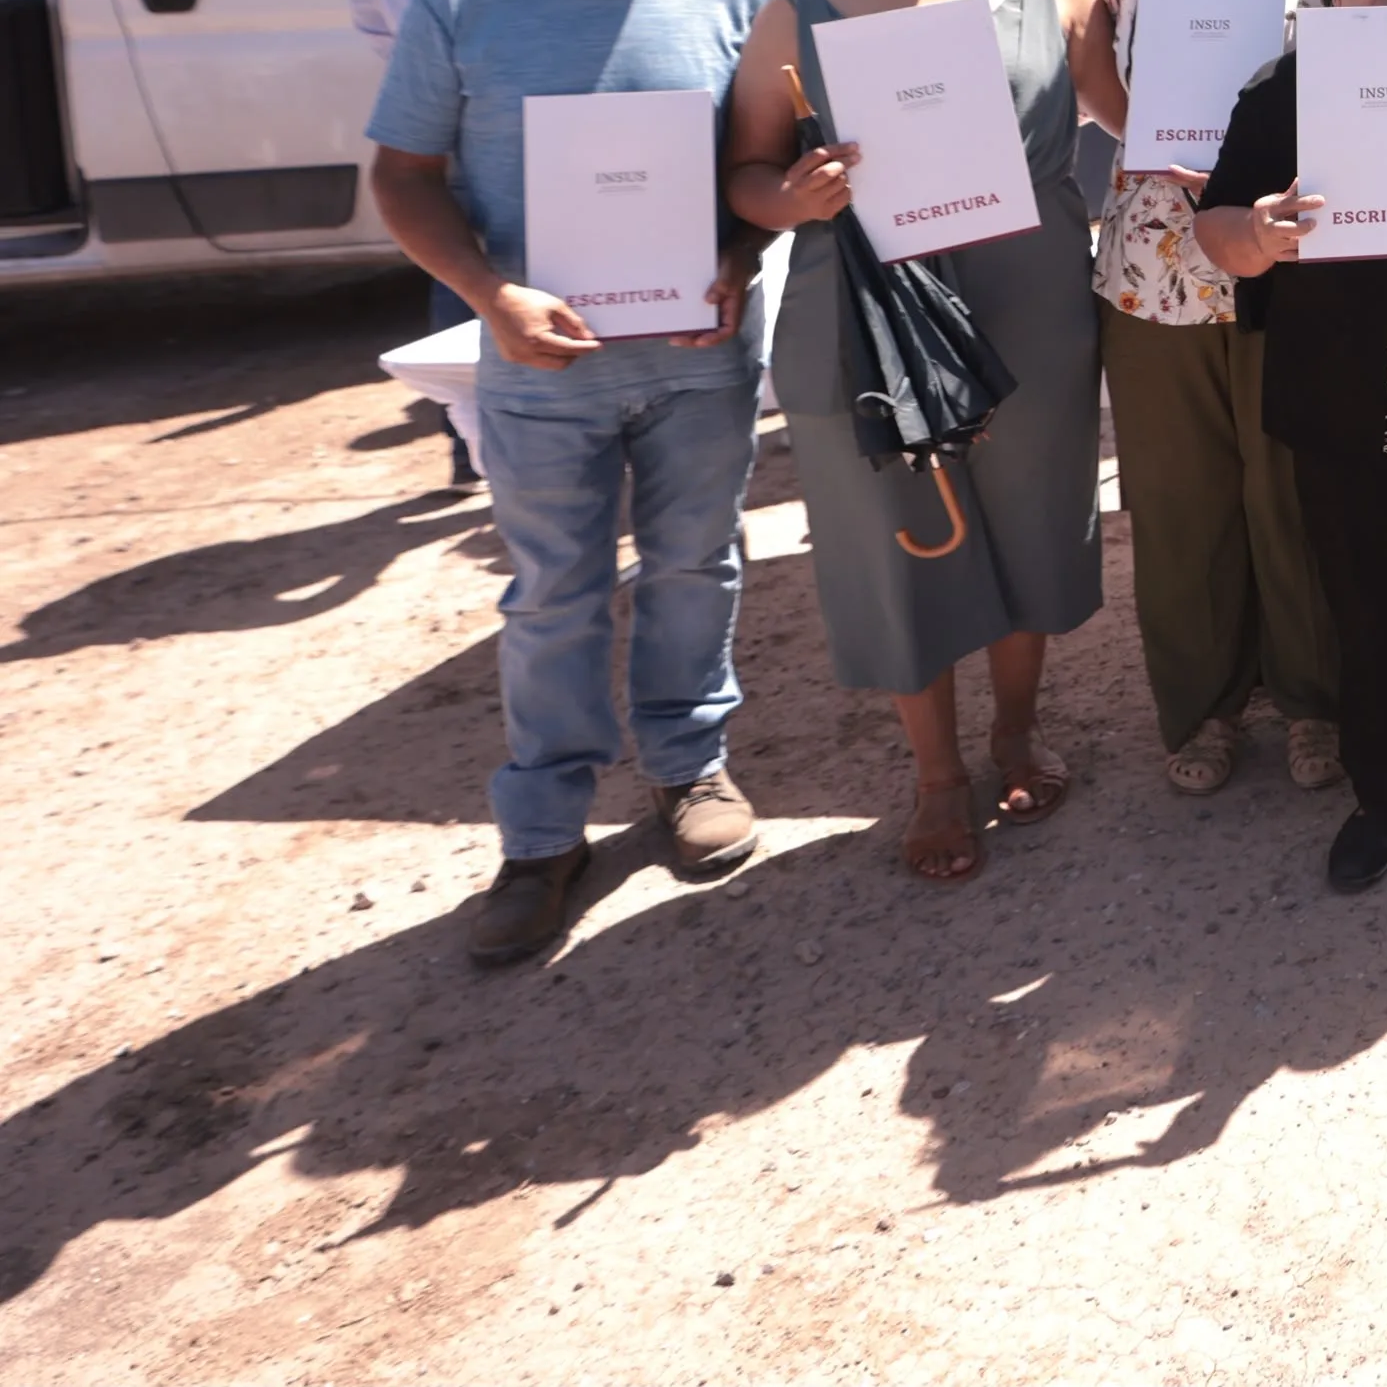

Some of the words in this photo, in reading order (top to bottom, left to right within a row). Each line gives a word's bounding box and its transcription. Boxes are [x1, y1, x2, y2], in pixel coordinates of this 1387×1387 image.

[1189, 19, 1230, 31] INSUS
[896, 82, 946, 102] INSUS
[1155, 128, 1226, 142] ESCRITU
[595, 169, 649, 185] INSUS
[893, 191, 1002, 227] ESCRITURA
[566, 288, 681, 308] ESCRITURA
